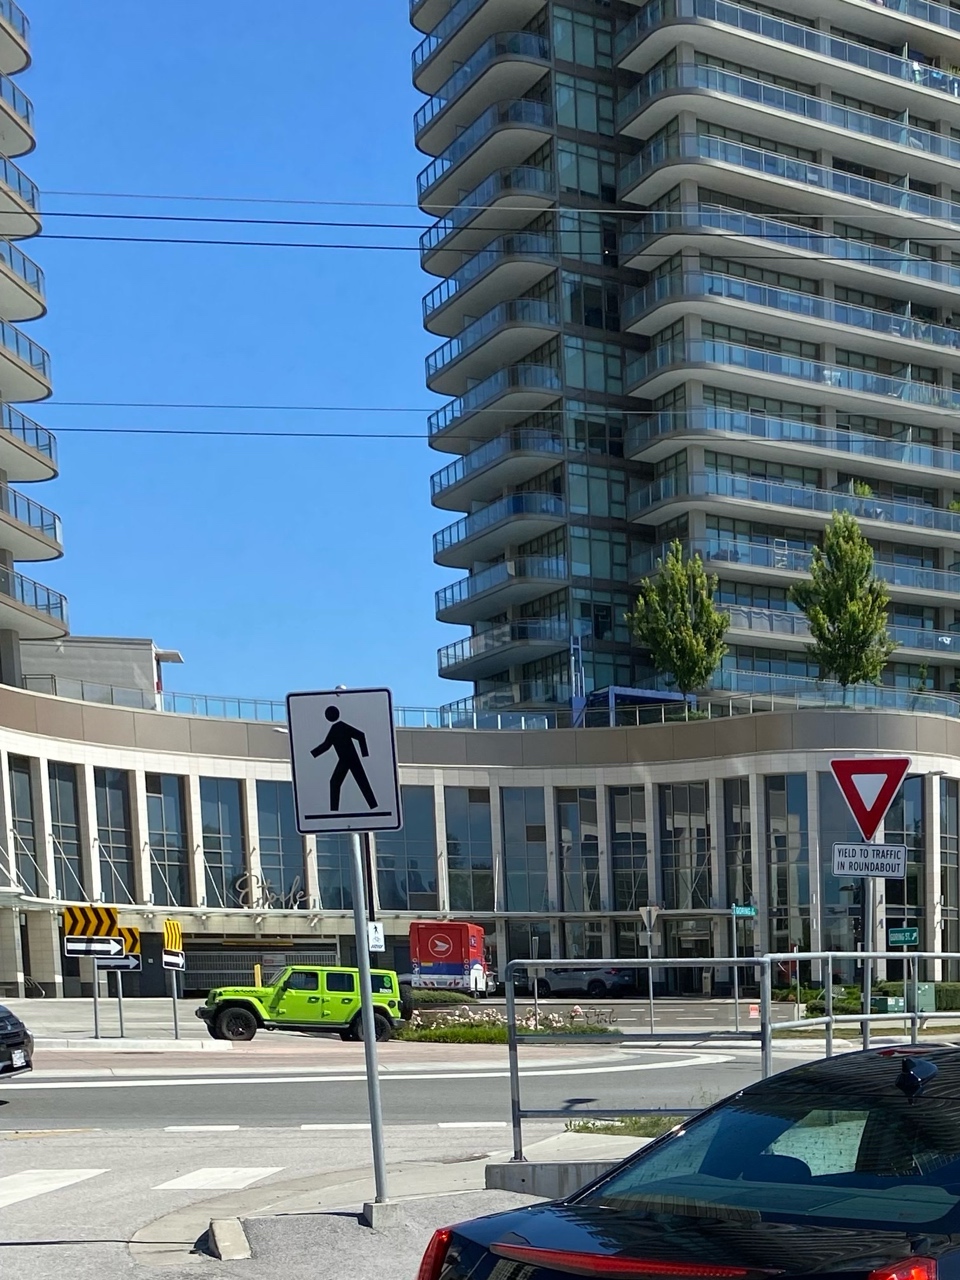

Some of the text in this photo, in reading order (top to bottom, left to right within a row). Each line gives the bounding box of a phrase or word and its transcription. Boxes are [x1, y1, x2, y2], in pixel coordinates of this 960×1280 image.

[837, 848, 902, 860] YIELD TO TRAFFIC
[837, 861, 901, 873] IN ROUNDABOUT
